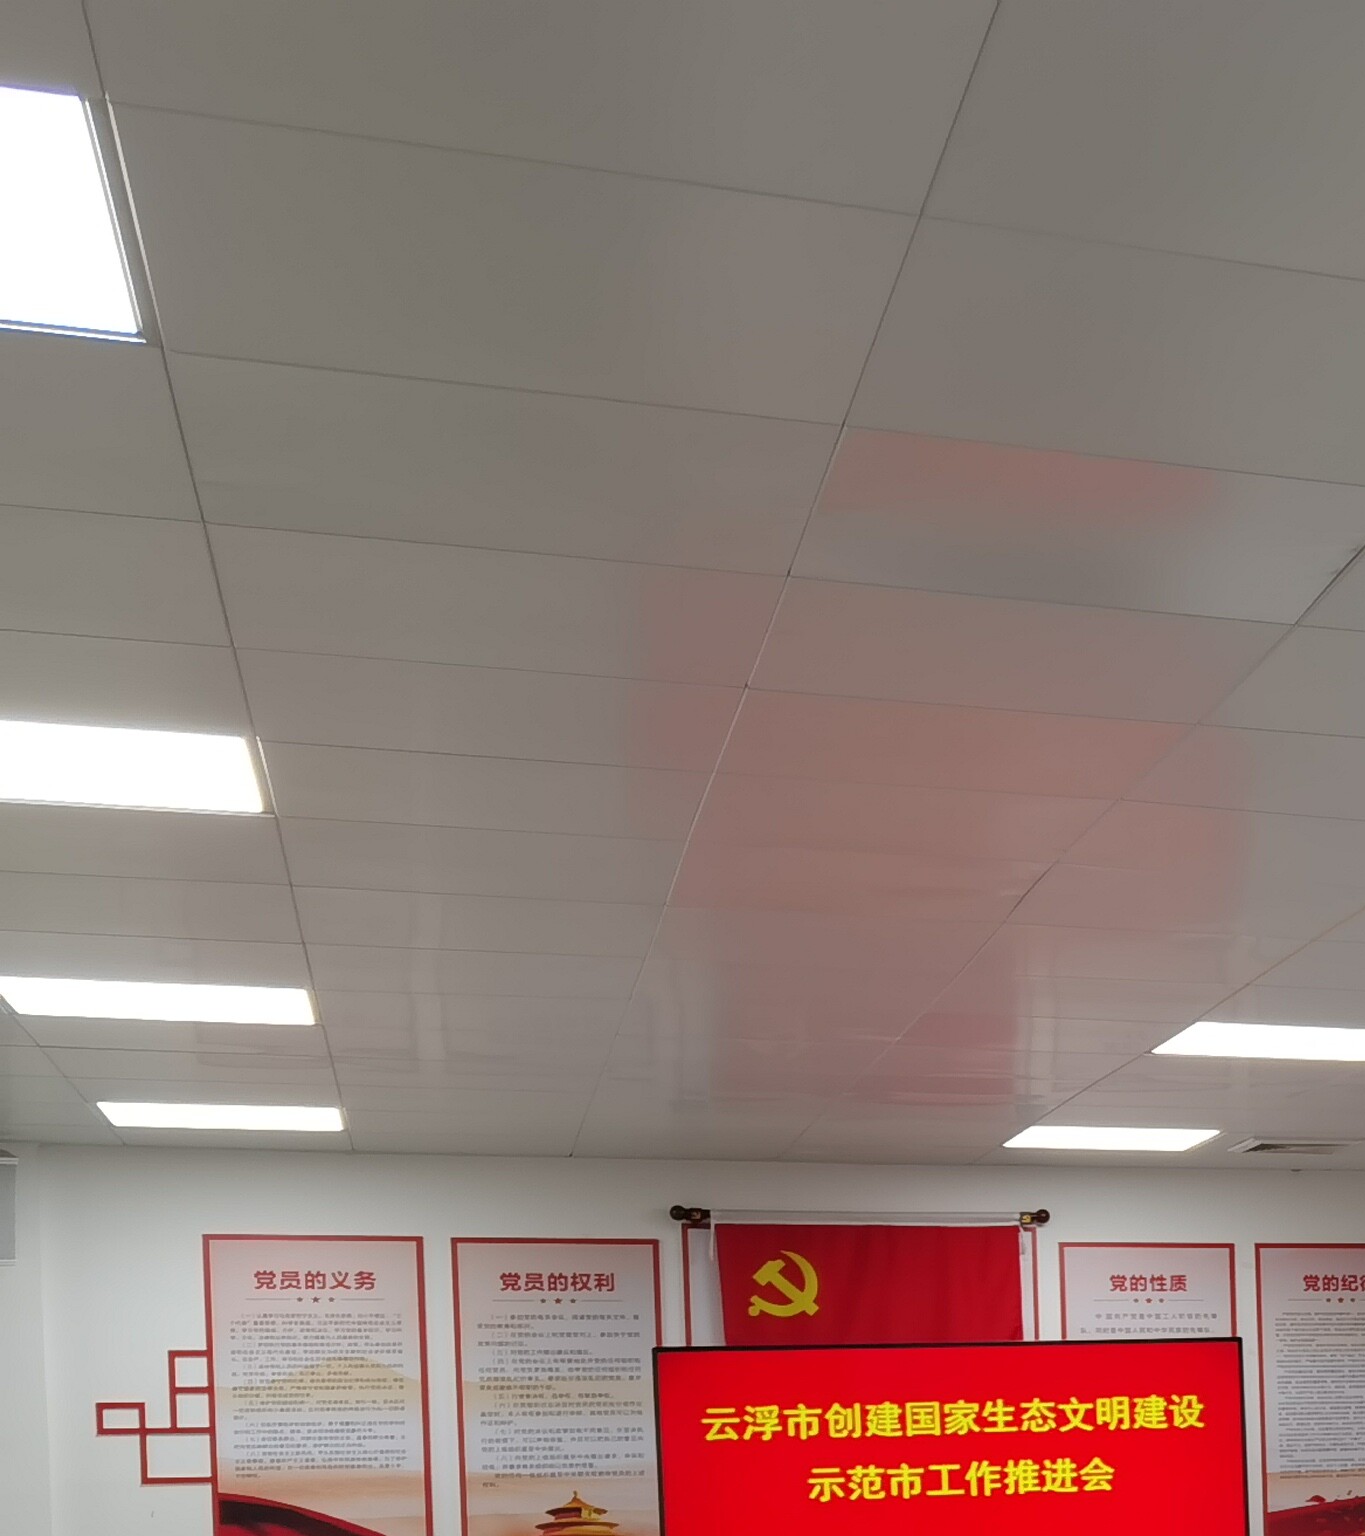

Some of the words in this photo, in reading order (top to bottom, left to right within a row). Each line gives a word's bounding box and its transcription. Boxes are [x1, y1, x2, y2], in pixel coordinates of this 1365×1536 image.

[253, 1270, 377, 1290] 党员的义务
[500, 1272, 616, 1292] 党员的权利
[1109, 1274, 1188, 1293] 党的性质
[702, 1393, 1205, 1442] 云浮市创建国家生态文明建设
[807, 1456, 1117, 1503] 示范市工作推进会
